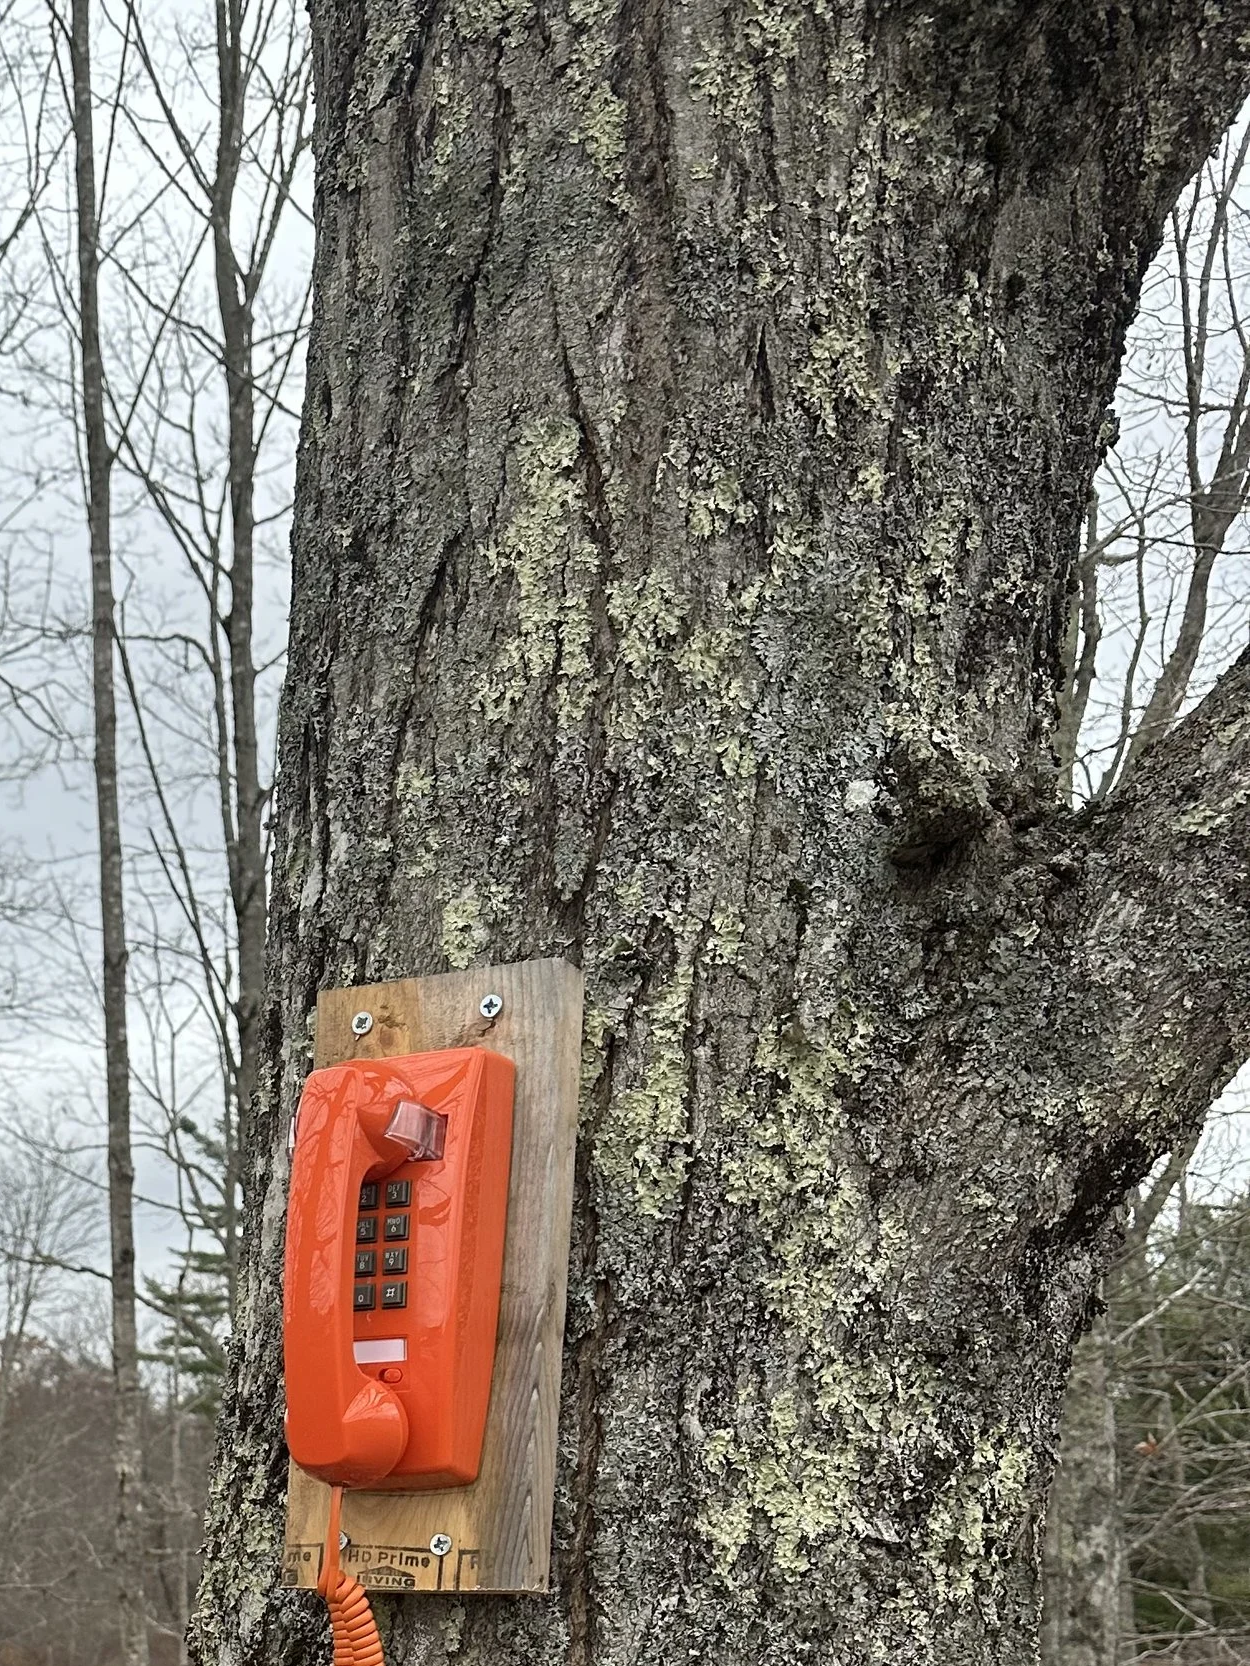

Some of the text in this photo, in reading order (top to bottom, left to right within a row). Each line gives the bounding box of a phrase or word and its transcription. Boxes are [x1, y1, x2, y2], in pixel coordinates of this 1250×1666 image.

[388, 1184, 400, 1192] DEF
[358, 1294, 364, 1302] 0
[377, 1551, 430, 1568] Prime
